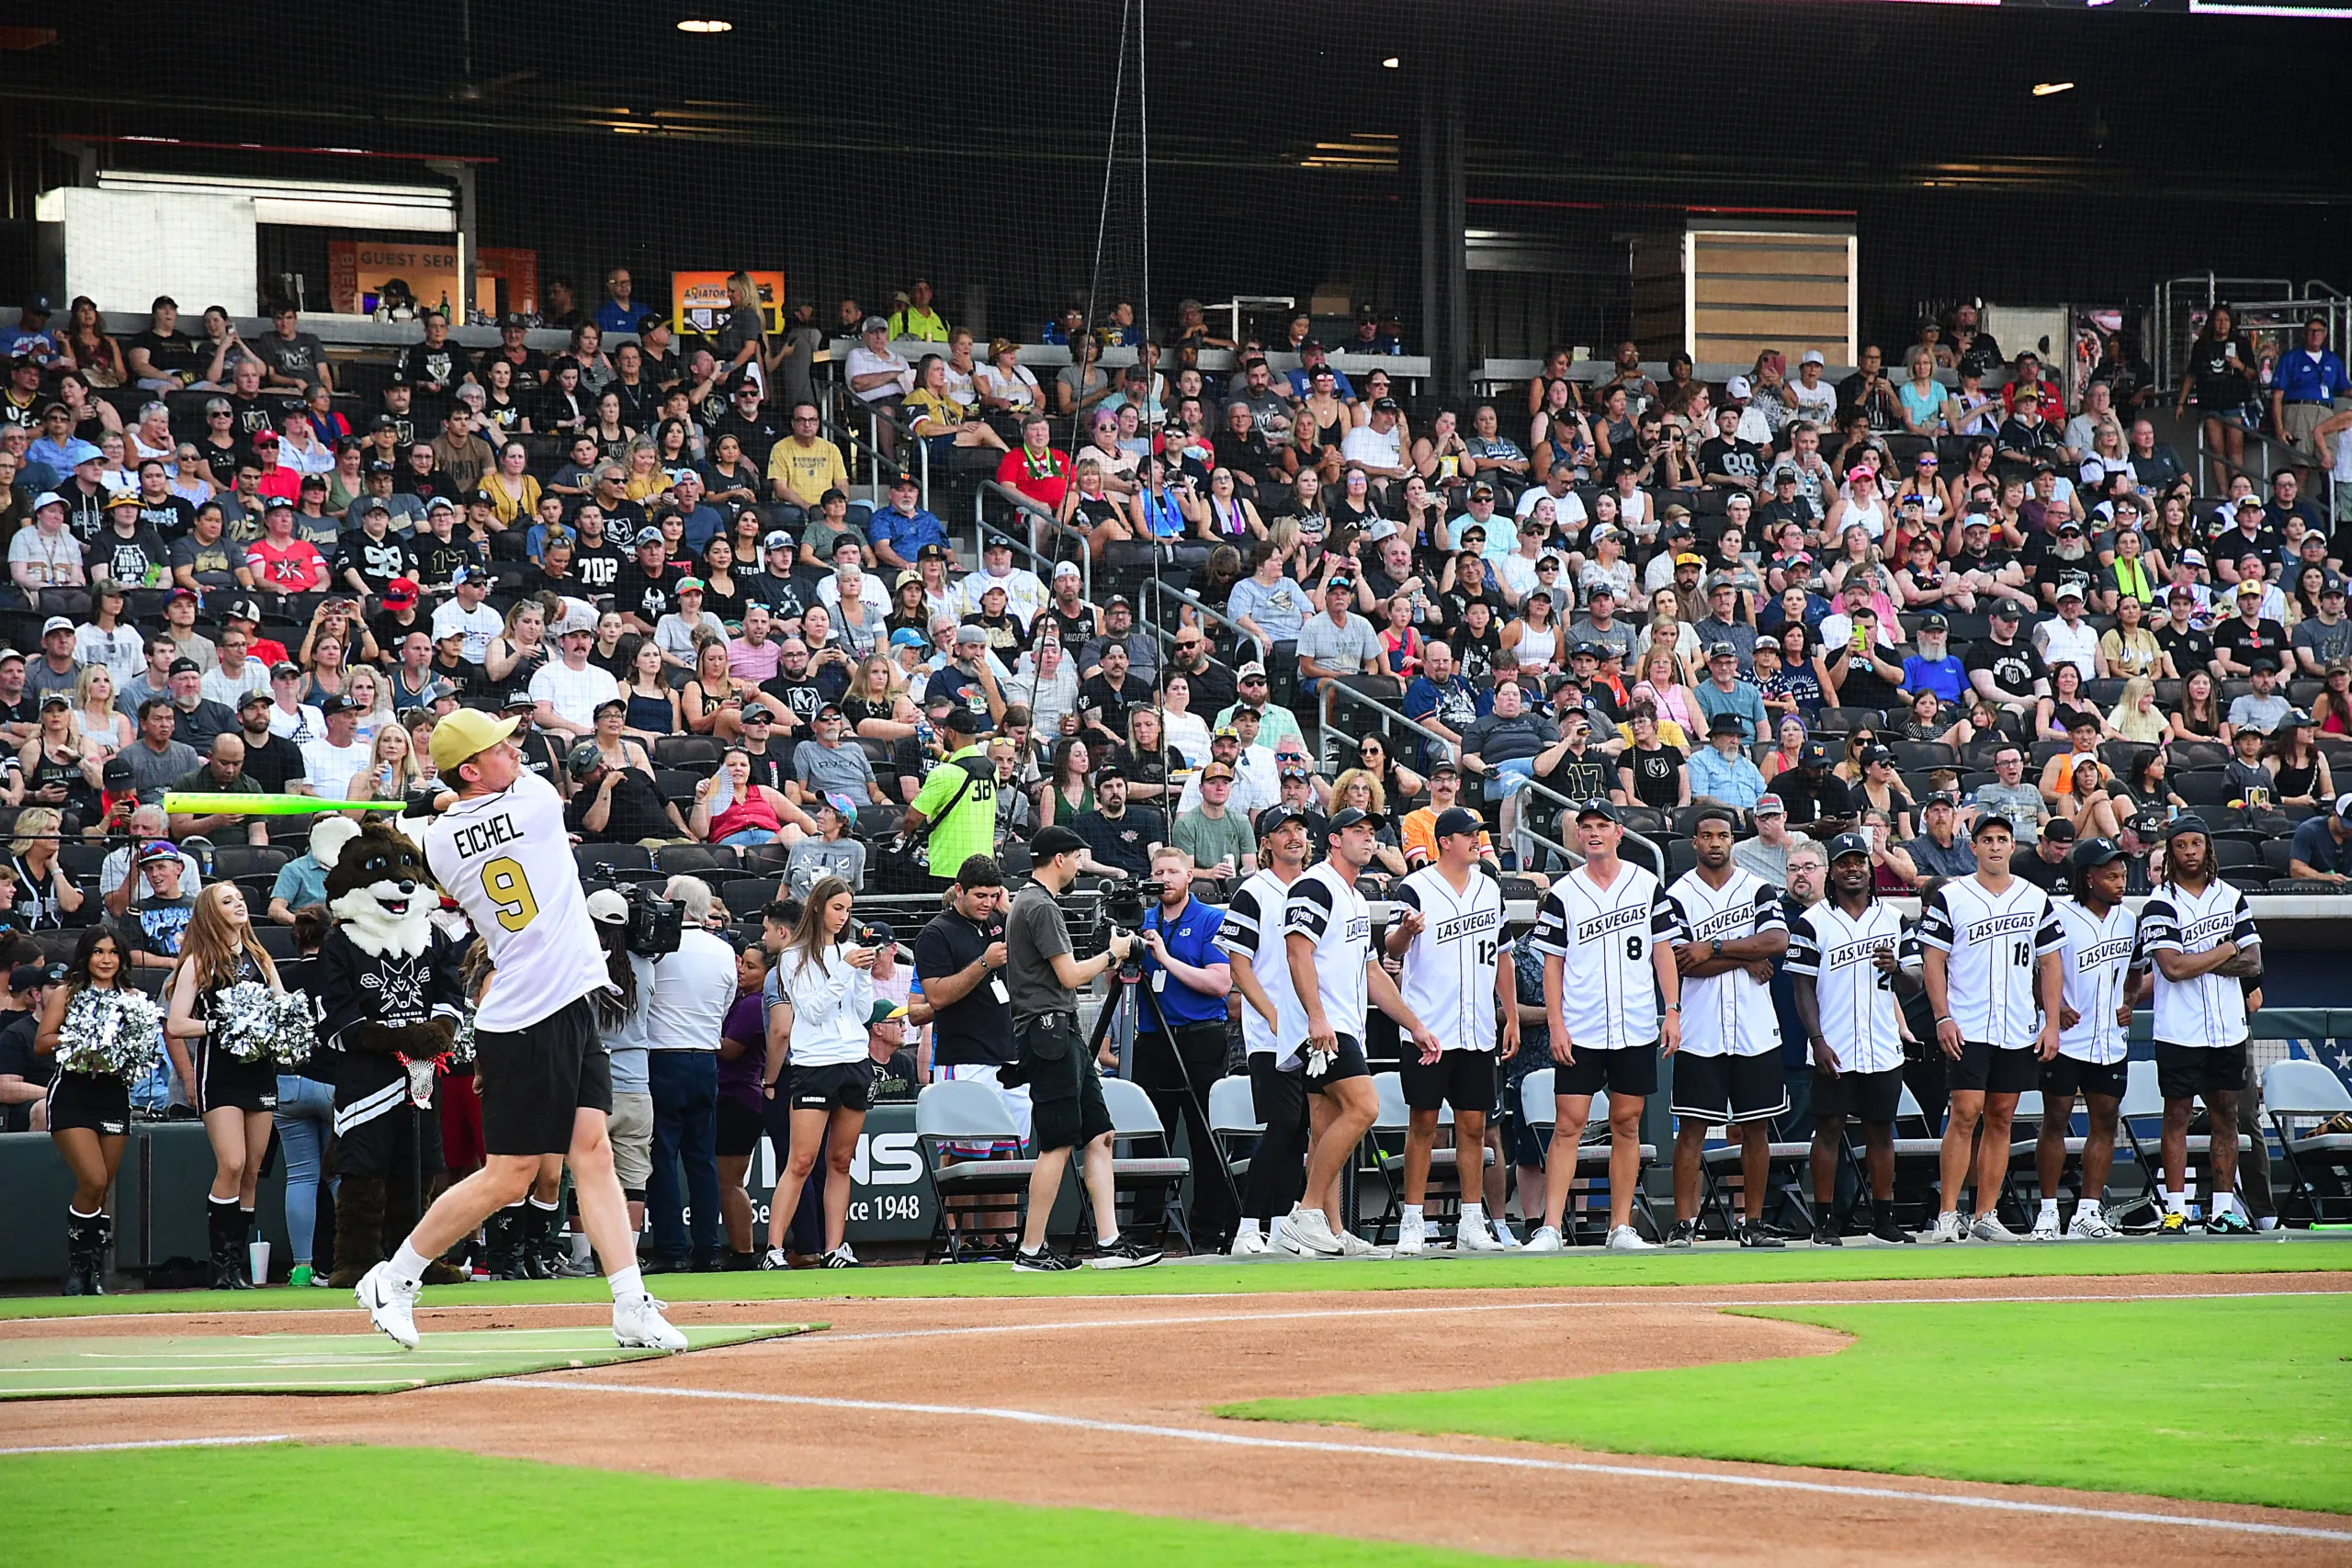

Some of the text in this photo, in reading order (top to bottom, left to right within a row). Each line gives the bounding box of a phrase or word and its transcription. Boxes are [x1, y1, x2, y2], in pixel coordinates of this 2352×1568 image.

[360, 251, 416, 268] GUEST
[364, 545, 402, 579] 98
[578, 558, 618, 583] 702
[971, 780, 991, 802] 38
[1567, 763, 1605, 801] 17
[1589, 798, 1600, 809] LV
[453, 812, 525, 859] EICHEL
[1843, 836, 1853, 847] LV
[480, 855, 539, 932] 9
[1291, 908, 1314, 923] Vegas
[1437, 912, 1496, 940] LAS VEGAS
[1578, 907, 1645, 940] LAS VEGAS
[1716, 905, 1754, 931] VEGAS
[2199, 915, 2233, 933] VEGAS
[1969, 916, 2035, 941] LAS VEGAS
[1478, 940, 1497, 966] 12
[1626, 936, 1642, 960] 8
[1830, 949, 1854, 966] LAS
[2014, 942, 2030, 967] 18
[2079, 941, 2132, 968] LAS VEGAS
[976, 1165, 1001, 1173] BATTLE
[874, 1195, 920, 1220] 1948
